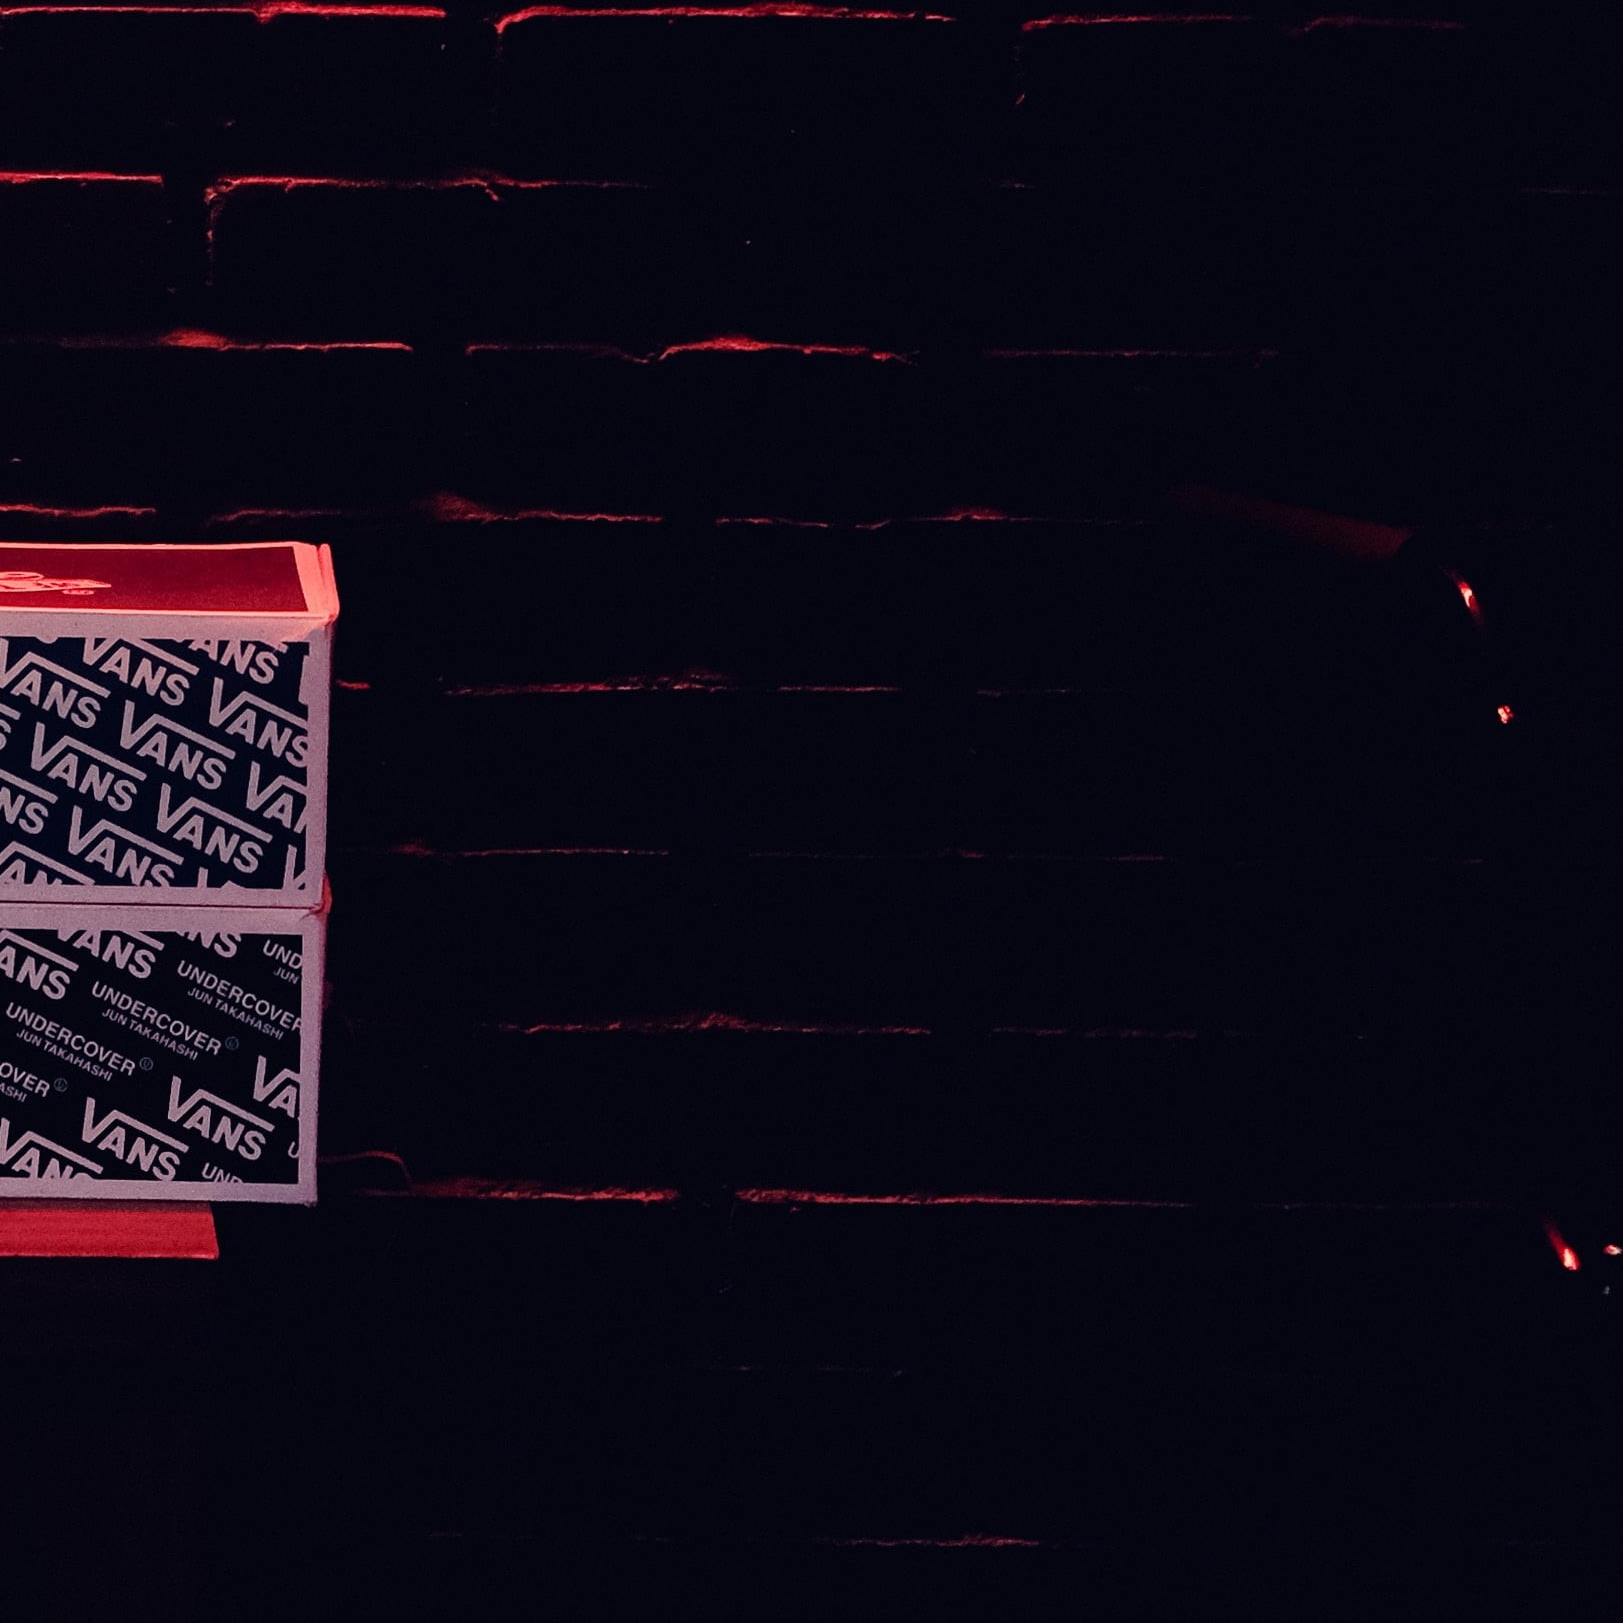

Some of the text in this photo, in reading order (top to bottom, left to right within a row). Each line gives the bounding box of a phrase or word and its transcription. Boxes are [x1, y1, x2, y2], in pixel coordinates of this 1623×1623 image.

[31, 721, 147, 813] VANS
[120, 699, 237, 790] VANS
[157, 783, 273, 874] VANS
[5, 1002, 136, 1077] UNDERCOVER
[91, 981, 223, 1055] UNDERCOVER
[102, 1008, 198, 1061] JUN TAKAHASHI
[187, 986, 284, 1041] JUN TAKAHASHI
[16, 1029, 113, 1082] JUN TAKAHASHI
[81, 1096, 190, 1181] VANS
[168, 1075, 275, 1160] VANS
